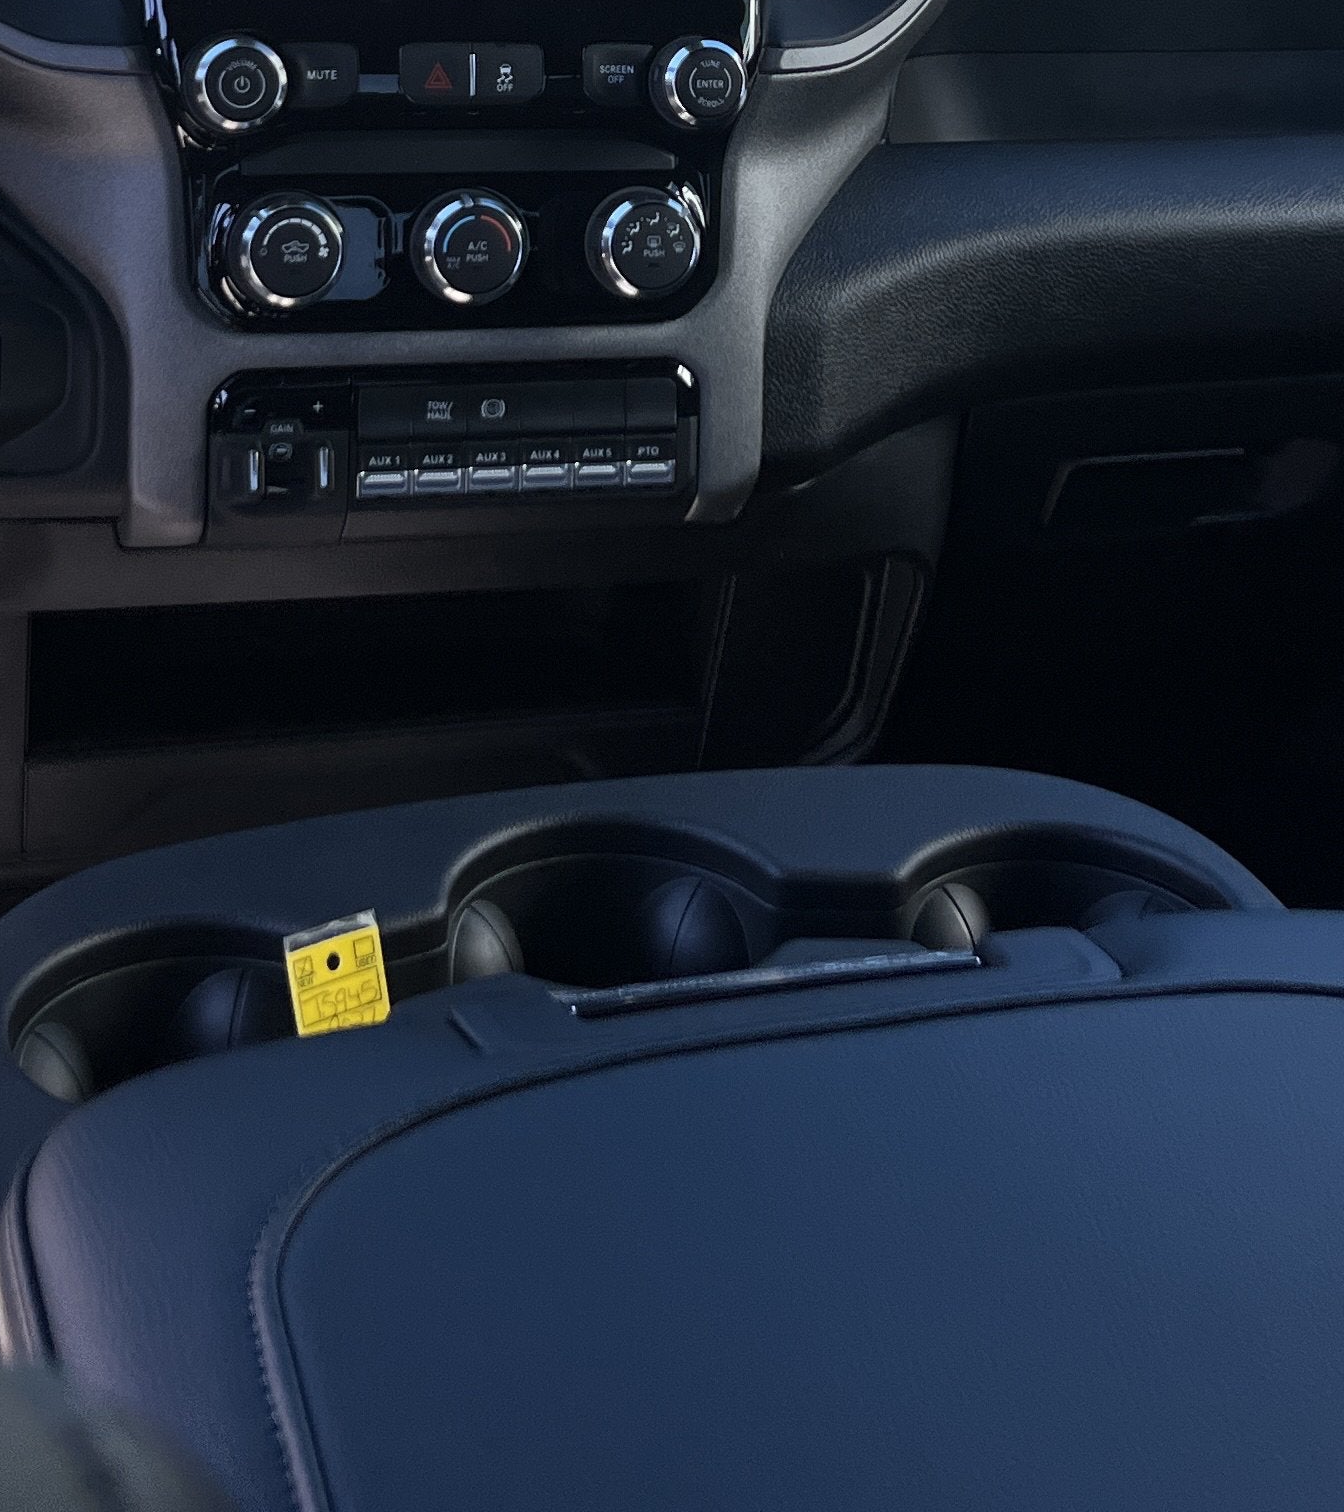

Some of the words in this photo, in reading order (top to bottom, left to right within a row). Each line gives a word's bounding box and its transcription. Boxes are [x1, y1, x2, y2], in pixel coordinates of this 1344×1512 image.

[599, 64, 635, 74] SCREEN
[699, 59, 722, 69] TUNE
[306, 69, 338, 80] MUTE
[607, 74, 625, 84] OFF
[696, 79, 725, 89] ENTER
[467, 240, 488, 251] A/C
[465, 253, 489, 262] PUSH
[270, 424, 294, 434] GAIN
[530, 450, 553, 460] AUX
[582, 448, 604, 458] AUX
[637, 445, 660, 456] PTO
[368, 457, 392, 466] AUX
[395, 455, 400, 465] 1
[422, 455, 445, 465] AUX
[475, 453, 498, 463] AUX
